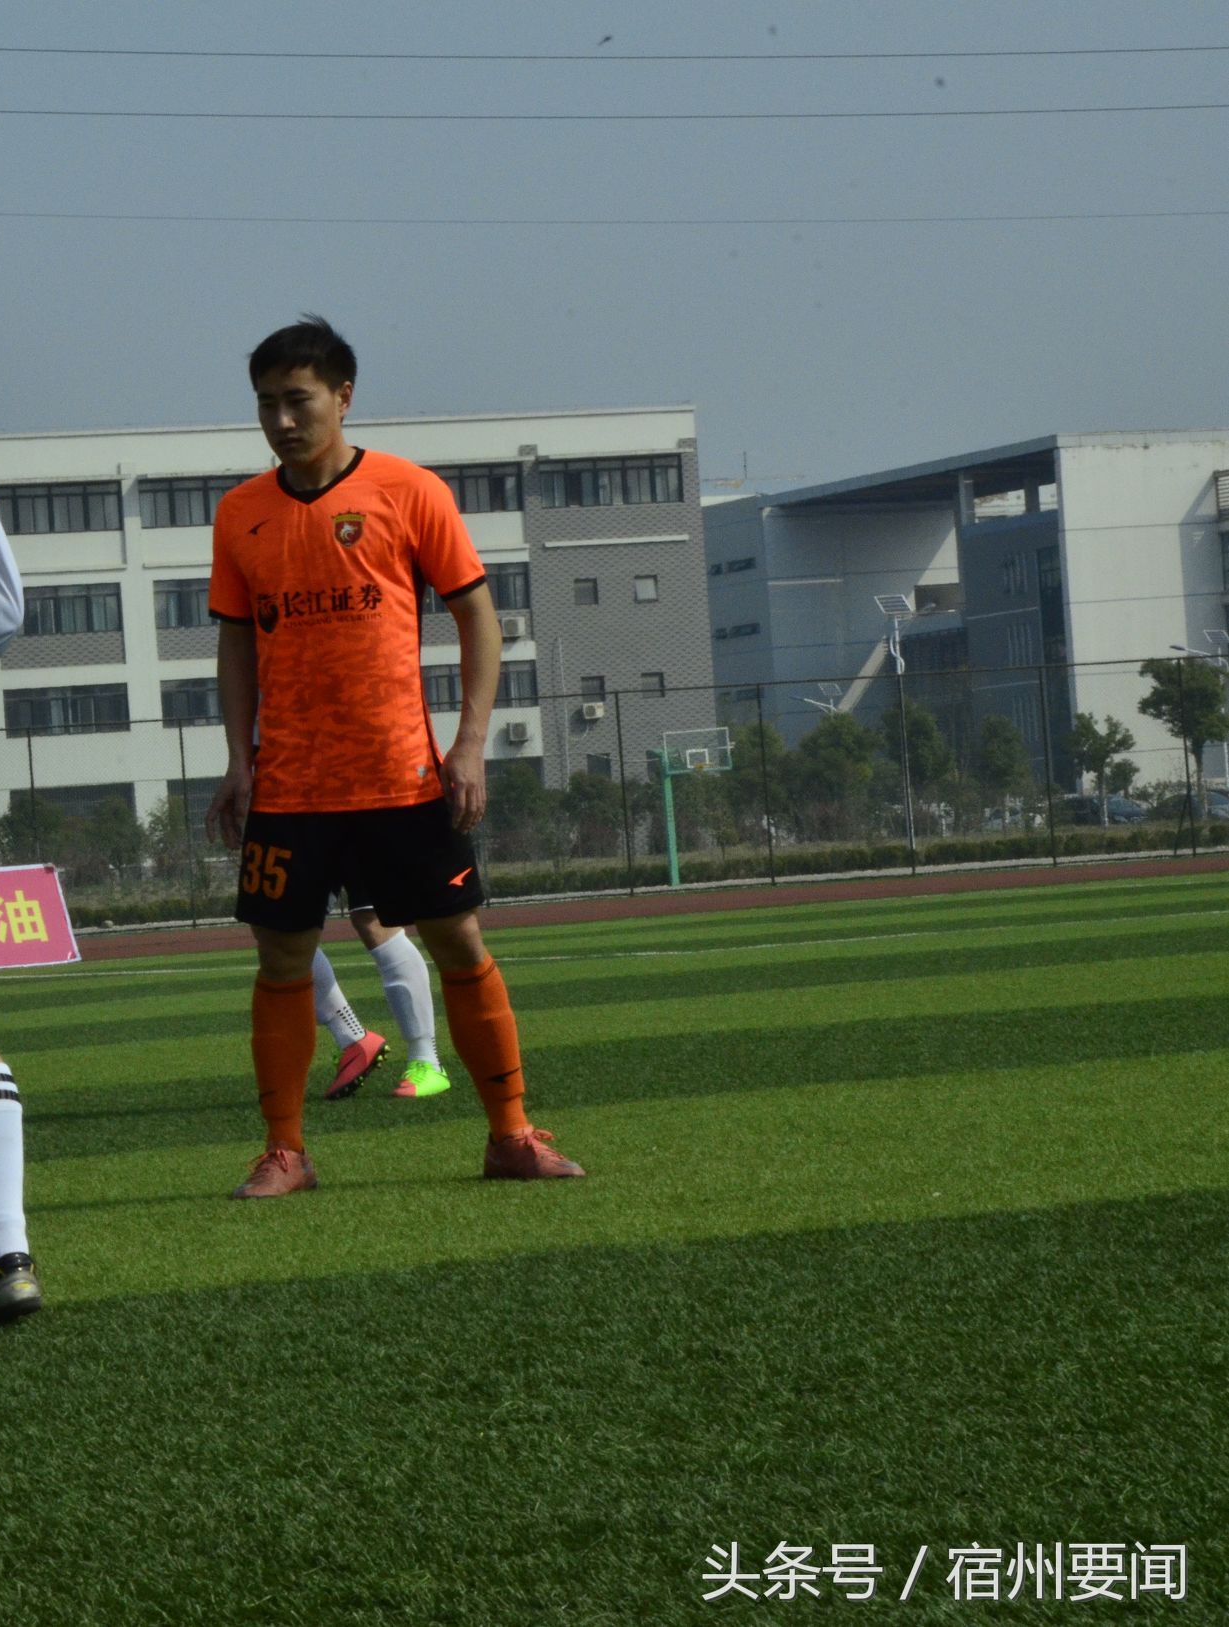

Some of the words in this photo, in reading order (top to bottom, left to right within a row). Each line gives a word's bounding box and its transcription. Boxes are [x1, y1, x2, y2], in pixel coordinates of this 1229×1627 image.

[282, 583, 383, 618] 长江证券
[240, 841, 292, 900] 35
